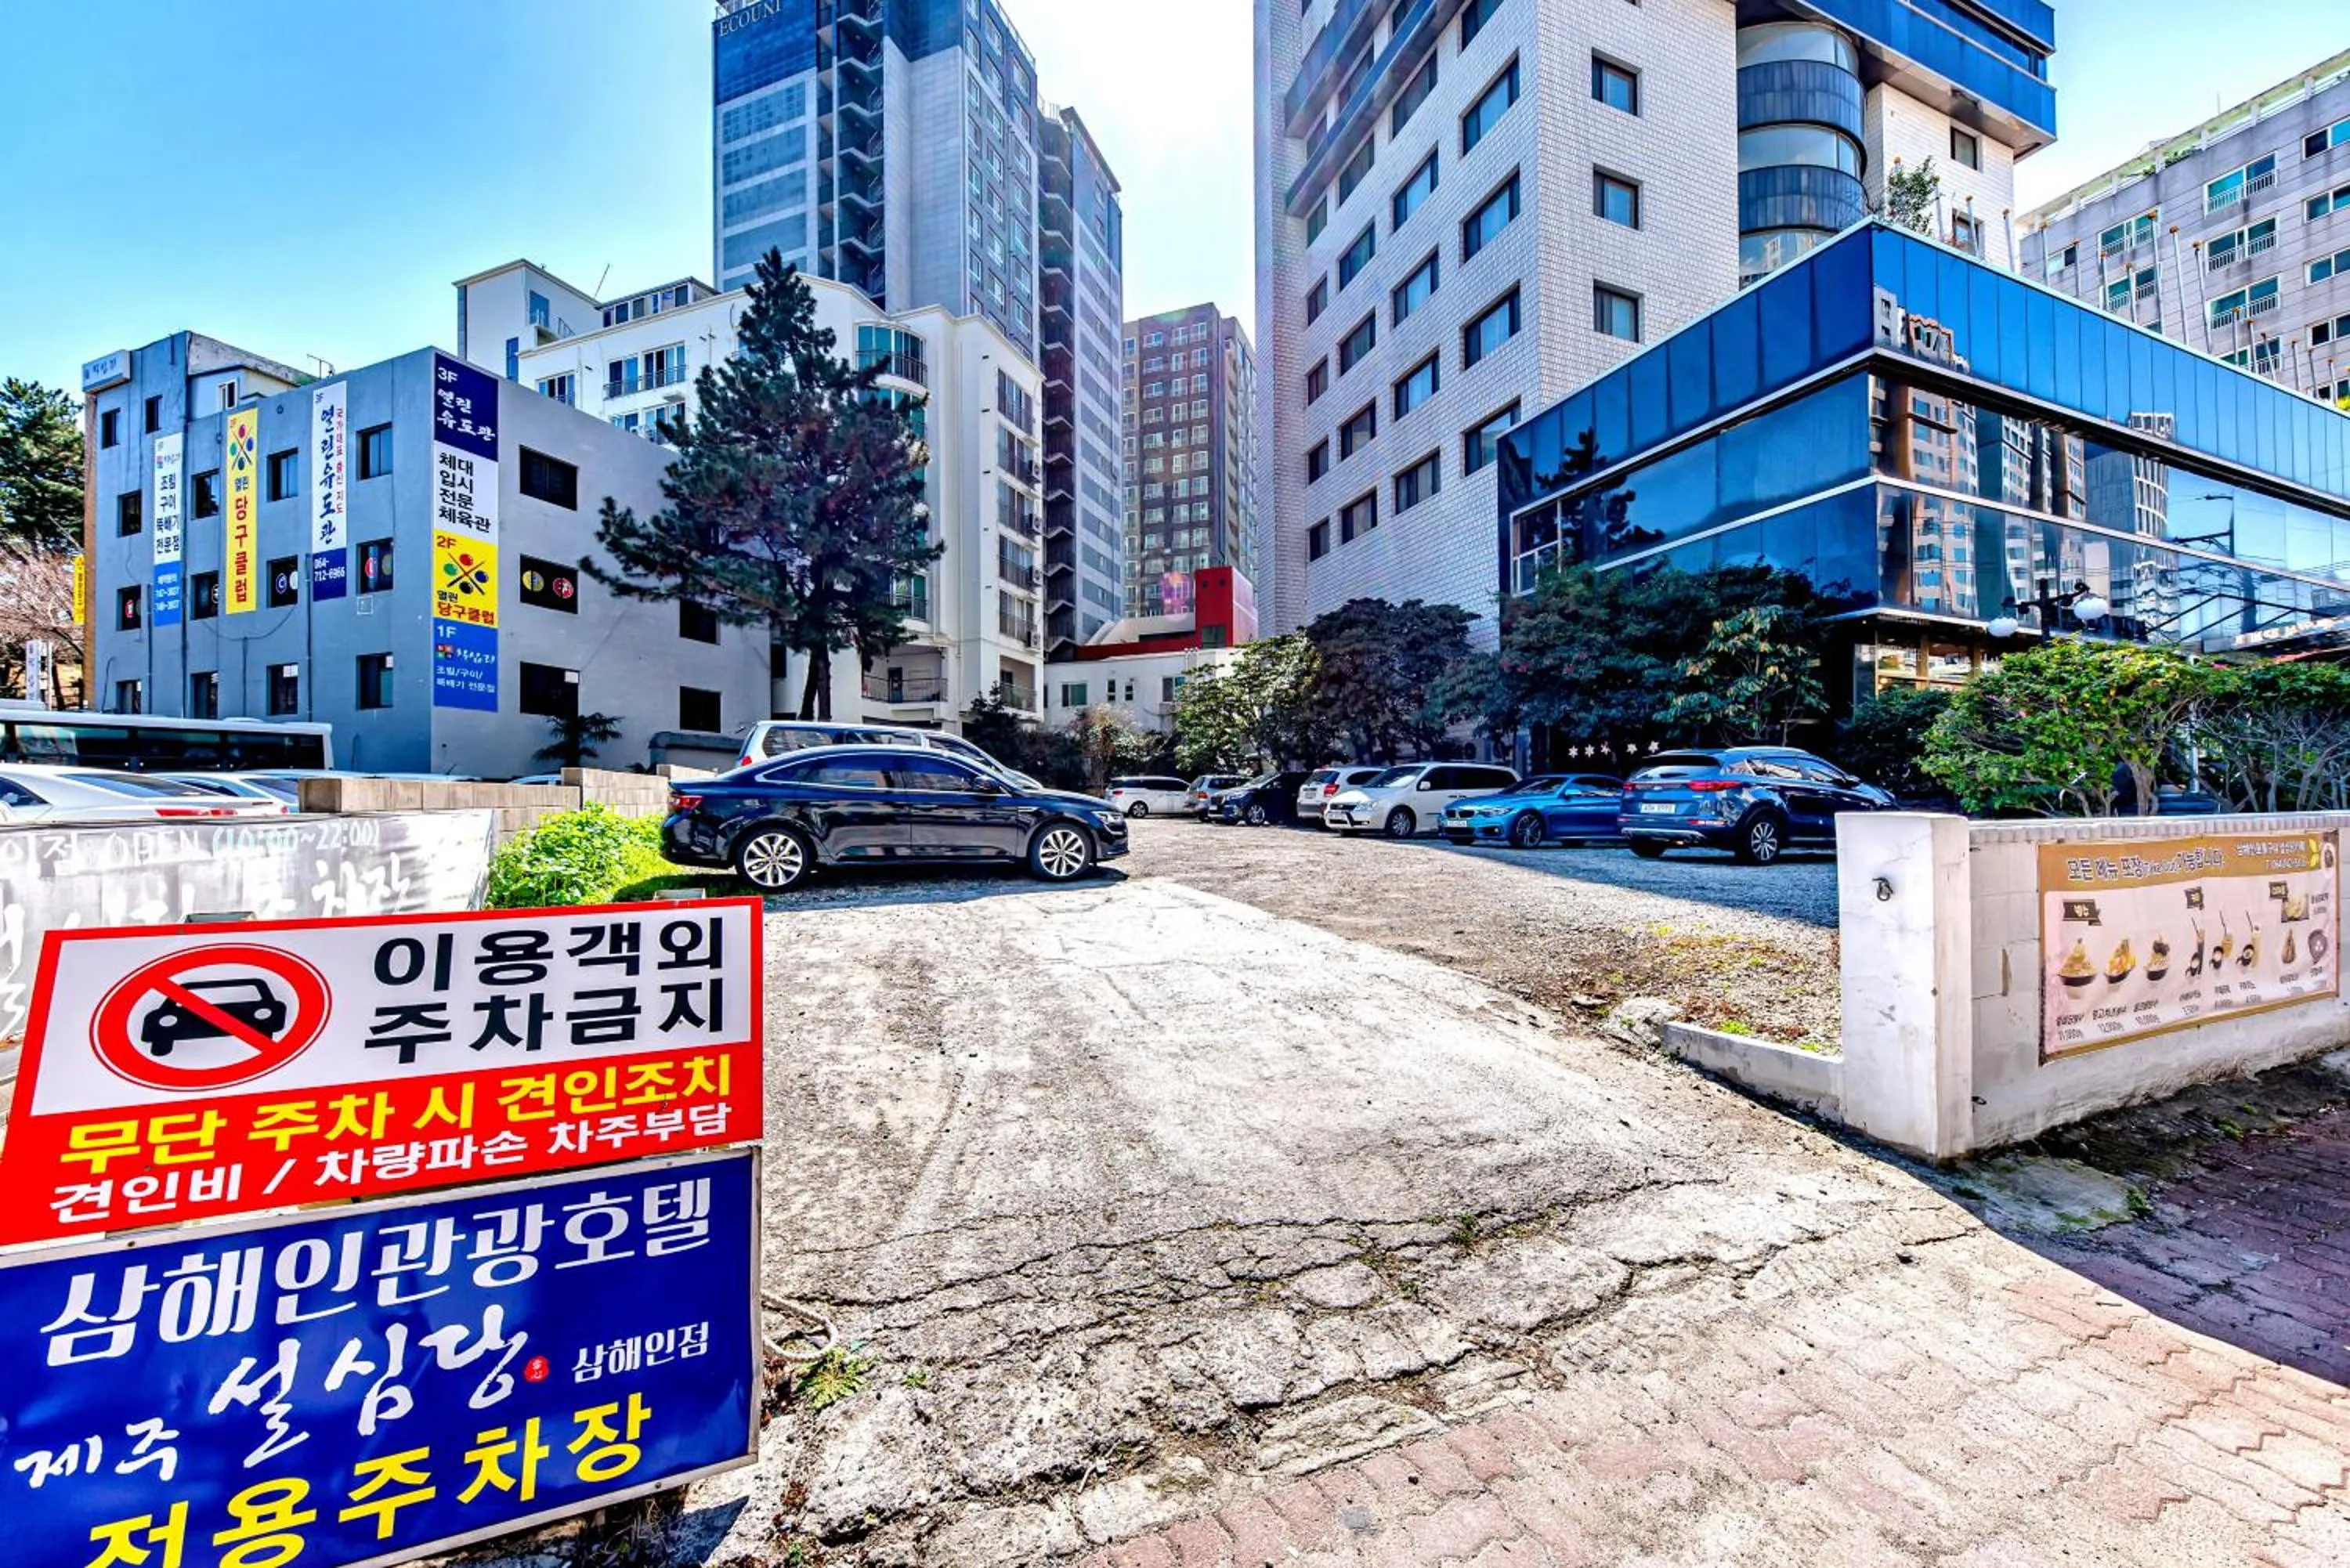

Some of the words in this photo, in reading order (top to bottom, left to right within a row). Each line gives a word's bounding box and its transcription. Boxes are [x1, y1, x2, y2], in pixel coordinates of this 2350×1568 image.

[437, 367, 458, 383] 3F
[436, 410, 496, 442] 유도관
[320, 404, 336, 544] 열린유도관
[439, 452, 474, 477] 체대
[439, 470, 474, 494] 입시
[439, 488, 474, 511] 전문
[438, 506, 492, 533] 체육관
[234, 495, 248, 603] 당구클럽
[436, 535, 457, 549] 2F
[436, 590, 458, 602] 열린
[436, 601, 495, 626] 당구클럽
[436, 625, 457, 638] 1F
[374, 917, 724, 992] 이용객외
[364, 977, 724, 1065] 주차금지
[61, 1110, 228, 1174] 무단
[249, 1092, 396, 1151] 주차
[413, 1082, 475, 1129] 시
[498, 1054, 730, 1122] 견인조치
[50, 1163, 243, 1223] 견인비
[262, 1158, 297, 1194] /
[314, 1130, 528, 1186] 차량파손
[548, 1102, 732, 1154] 차주부담
[40, 1177, 712, 1367] 삼해인관광호텔
[208, 1304, 530, 1469] 설심당
[572, 1321, 709, 1382] 삼해인점
[13, 1418, 179, 1488] 제주
